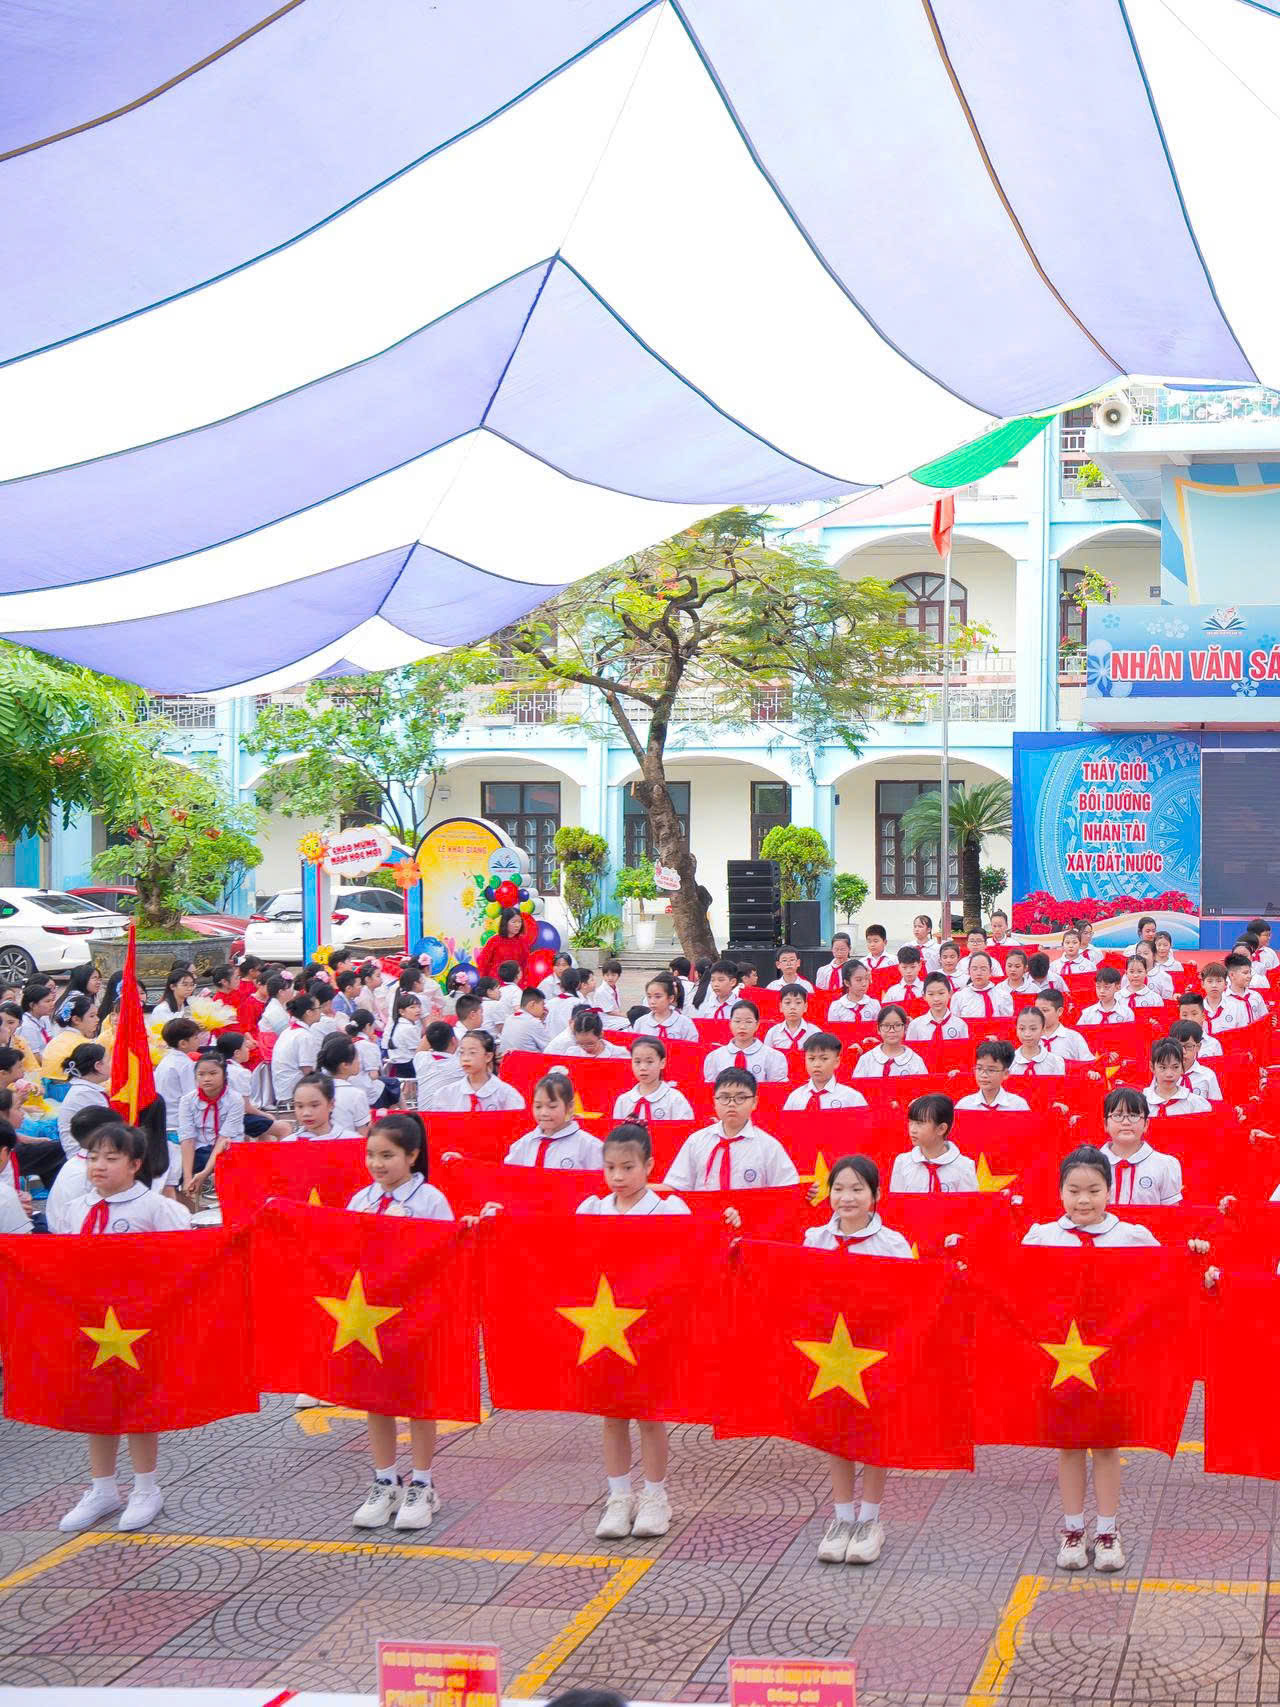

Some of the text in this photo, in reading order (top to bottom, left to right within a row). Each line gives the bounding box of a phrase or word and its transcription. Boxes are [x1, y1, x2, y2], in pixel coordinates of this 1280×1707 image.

[1110, 645, 1184, 681] NHÂN
[1190, 645, 1243, 681] VĂN
[1083, 757, 1148, 781] THẦY GIỎI
[1079, 788, 1151, 811] BỒI DƯỠNG
[1083, 820, 1146, 842] NHÂN TÀI
[1067, 848, 1163, 873] XÂY ĐẤT NƯỚC
